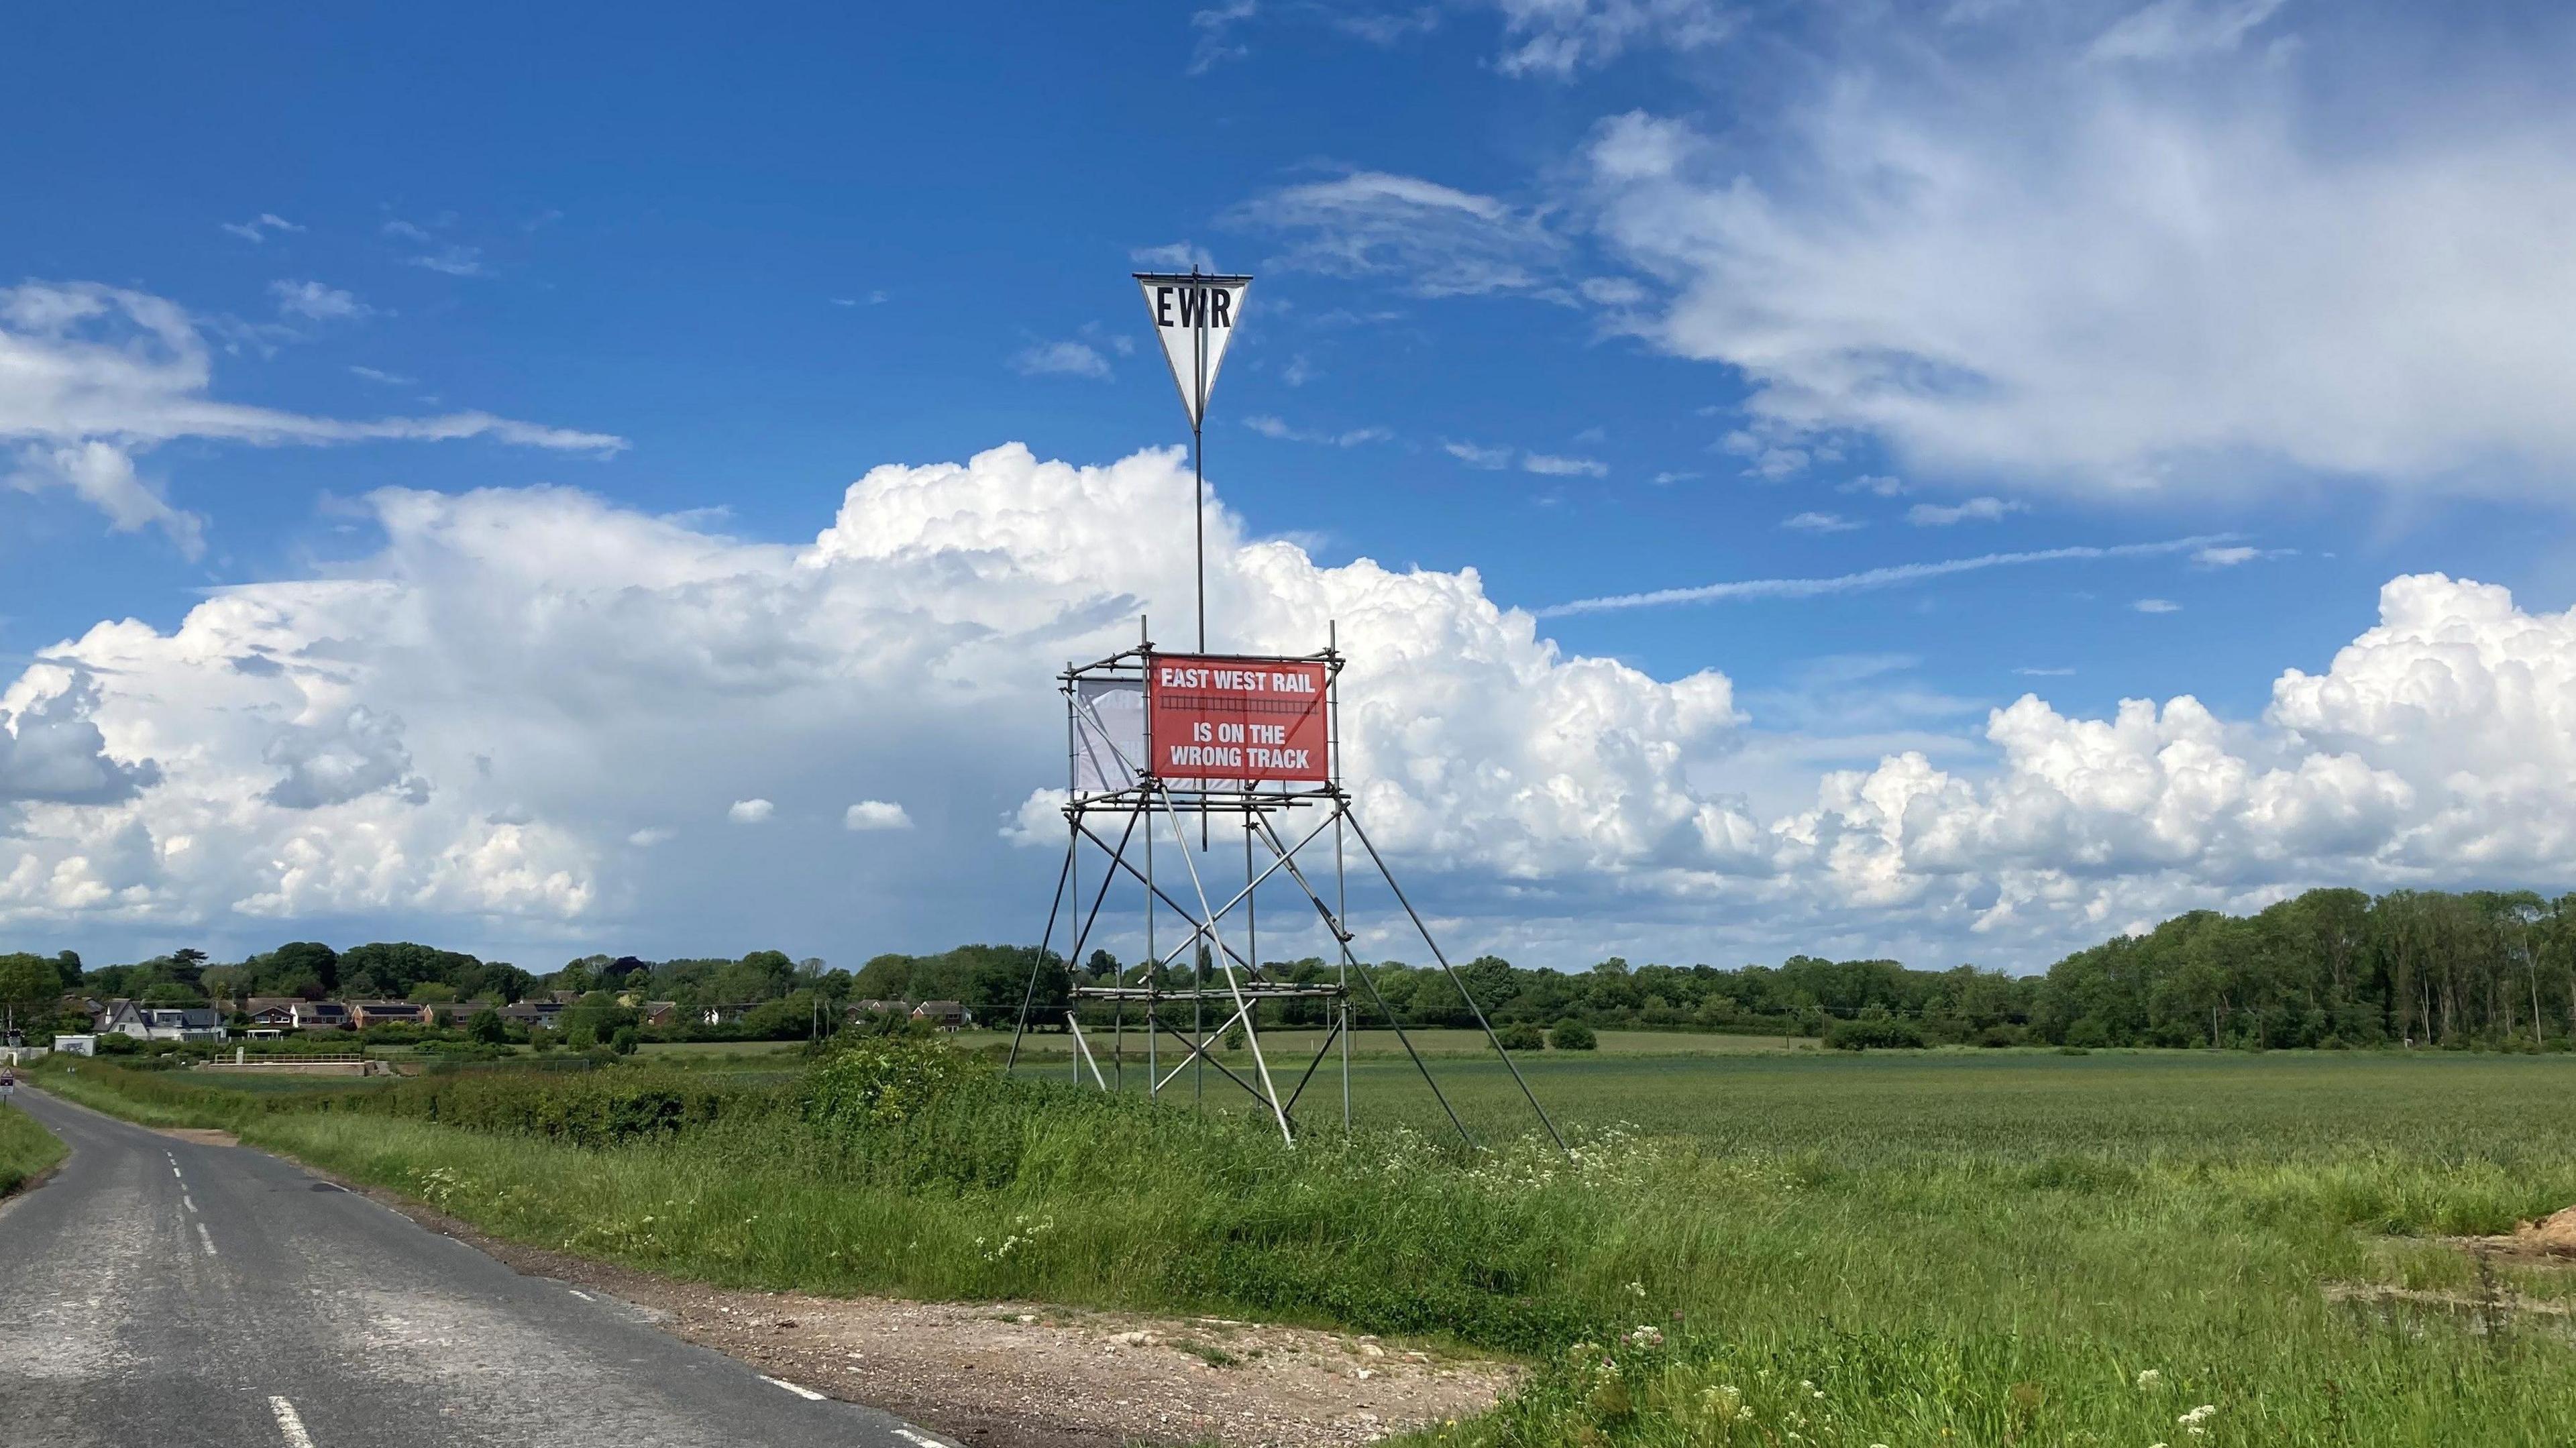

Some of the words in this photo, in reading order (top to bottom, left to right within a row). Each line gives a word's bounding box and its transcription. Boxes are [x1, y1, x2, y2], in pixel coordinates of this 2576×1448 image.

[1157, 287, 1230, 328] EWR
[1161, 668, 1209, 688] EAST
[1214, 669, 1267, 691] WEST
[1273, 673, 1316, 693] RAIL
[1193, 722, 1212, 742] IS
[1218, 723, 1244, 743] ON
[1249, 724, 1285, 744] THE
[1170, 746, 1241, 767] WRONG
[1246, 748, 1309, 769] TRACK
